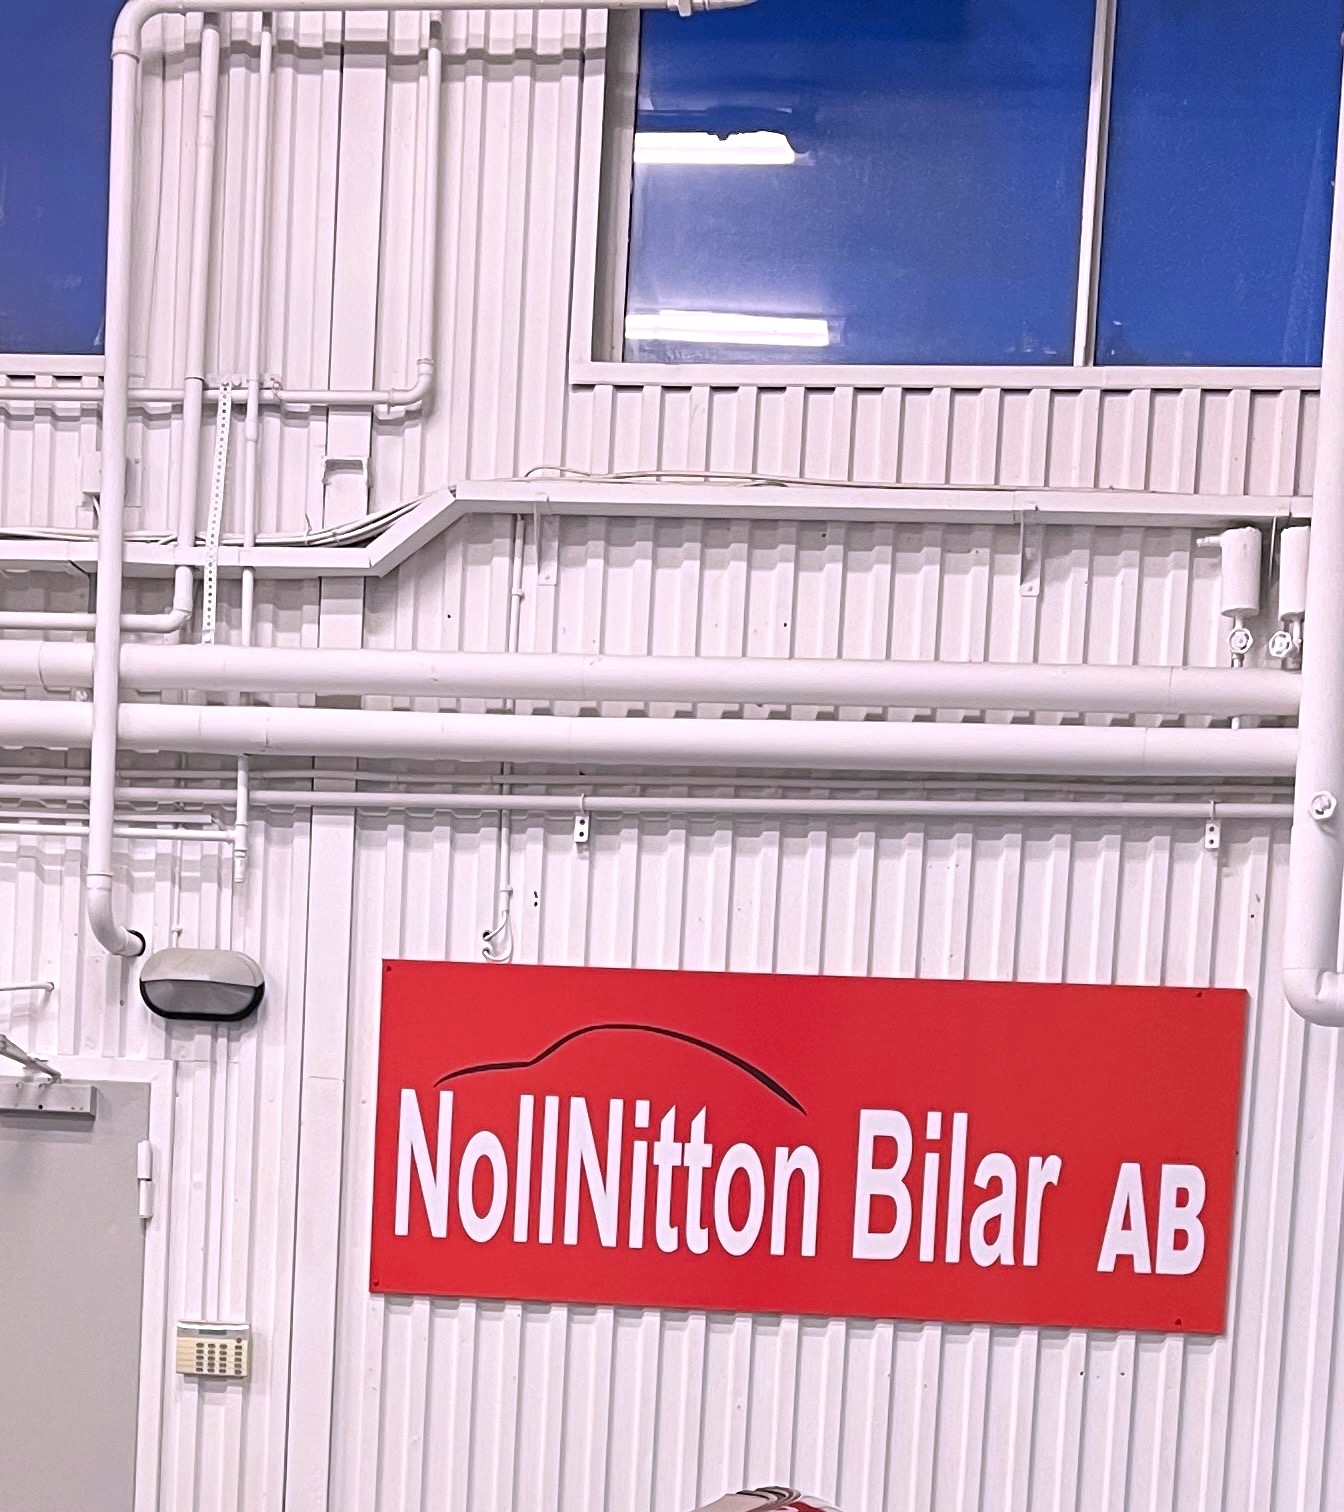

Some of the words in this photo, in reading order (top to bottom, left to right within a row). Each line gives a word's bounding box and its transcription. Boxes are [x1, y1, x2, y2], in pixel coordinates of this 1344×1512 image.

[393, 1087, 821, 1257] NollNitton
[852, 1108, 1063, 1268] Bilar
[1096, 1161, 1207, 1276] AB
